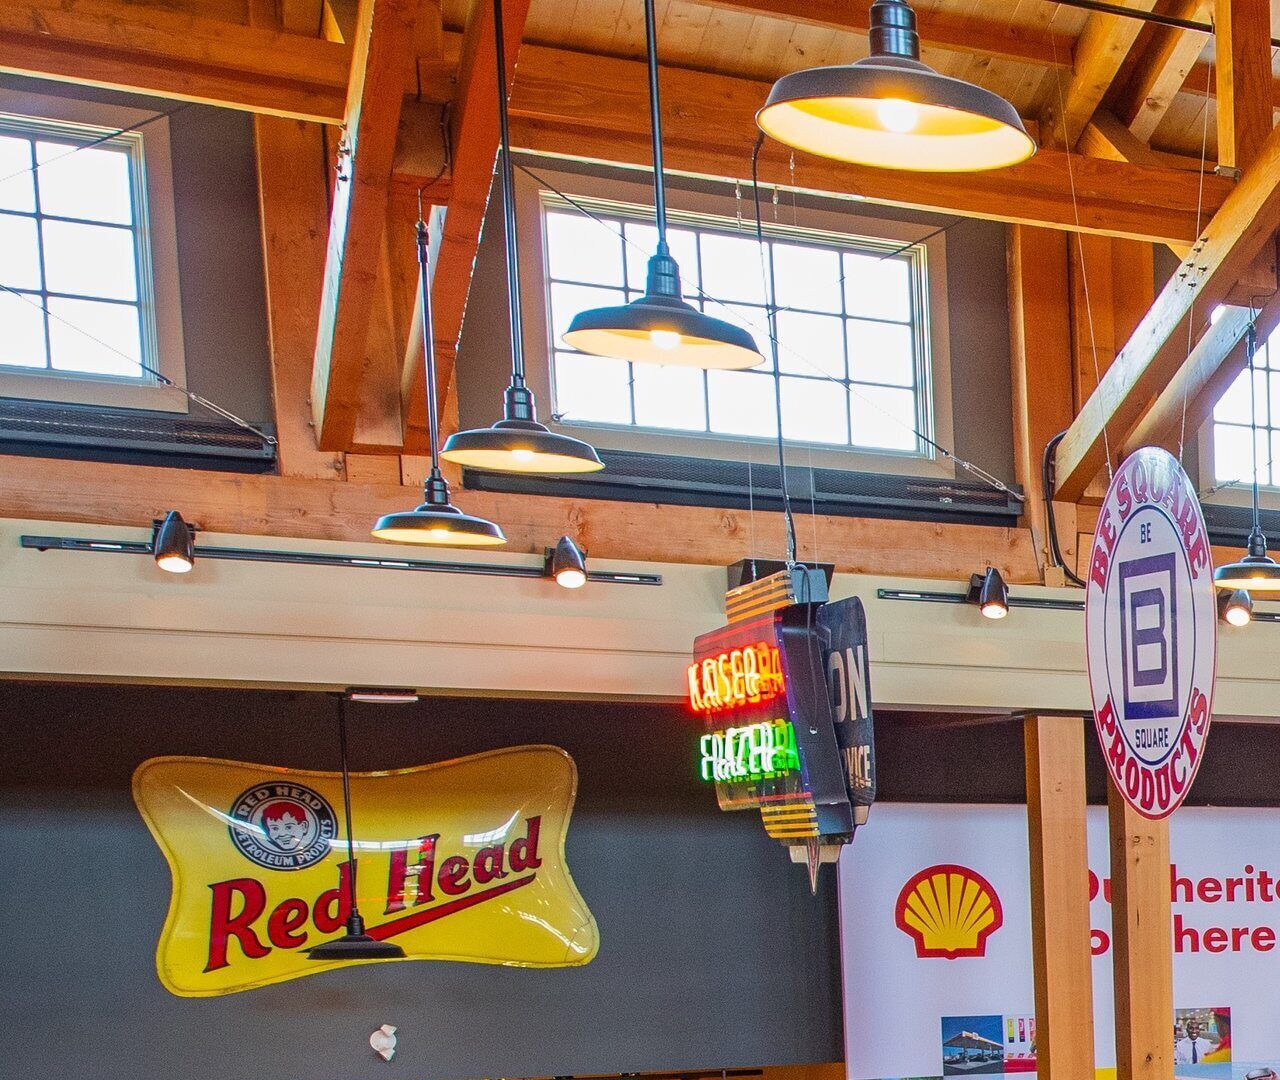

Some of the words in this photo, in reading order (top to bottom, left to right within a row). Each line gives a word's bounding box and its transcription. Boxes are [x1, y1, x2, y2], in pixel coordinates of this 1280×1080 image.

[1091, 507, 1117, 594] BE
[1116, 458, 1208, 580] SQUARE
[1140, 522, 1152, 544] BE
[688, 646, 768, 711] KAISER
[700, 721, 784, 781] FRAZER
[1098, 687, 1207, 811] PRODUCTS
[1135, 727, 1169, 749] SQUARE
[237, 789, 270, 816] RED
[276, 787, 322, 810] HEAD
[296, 819, 332, 863] PRODUCTS
[203, 858, 358, 974] Red
[384, 815, 543, 916] Head
[1173, 914, 1276, 954] here
